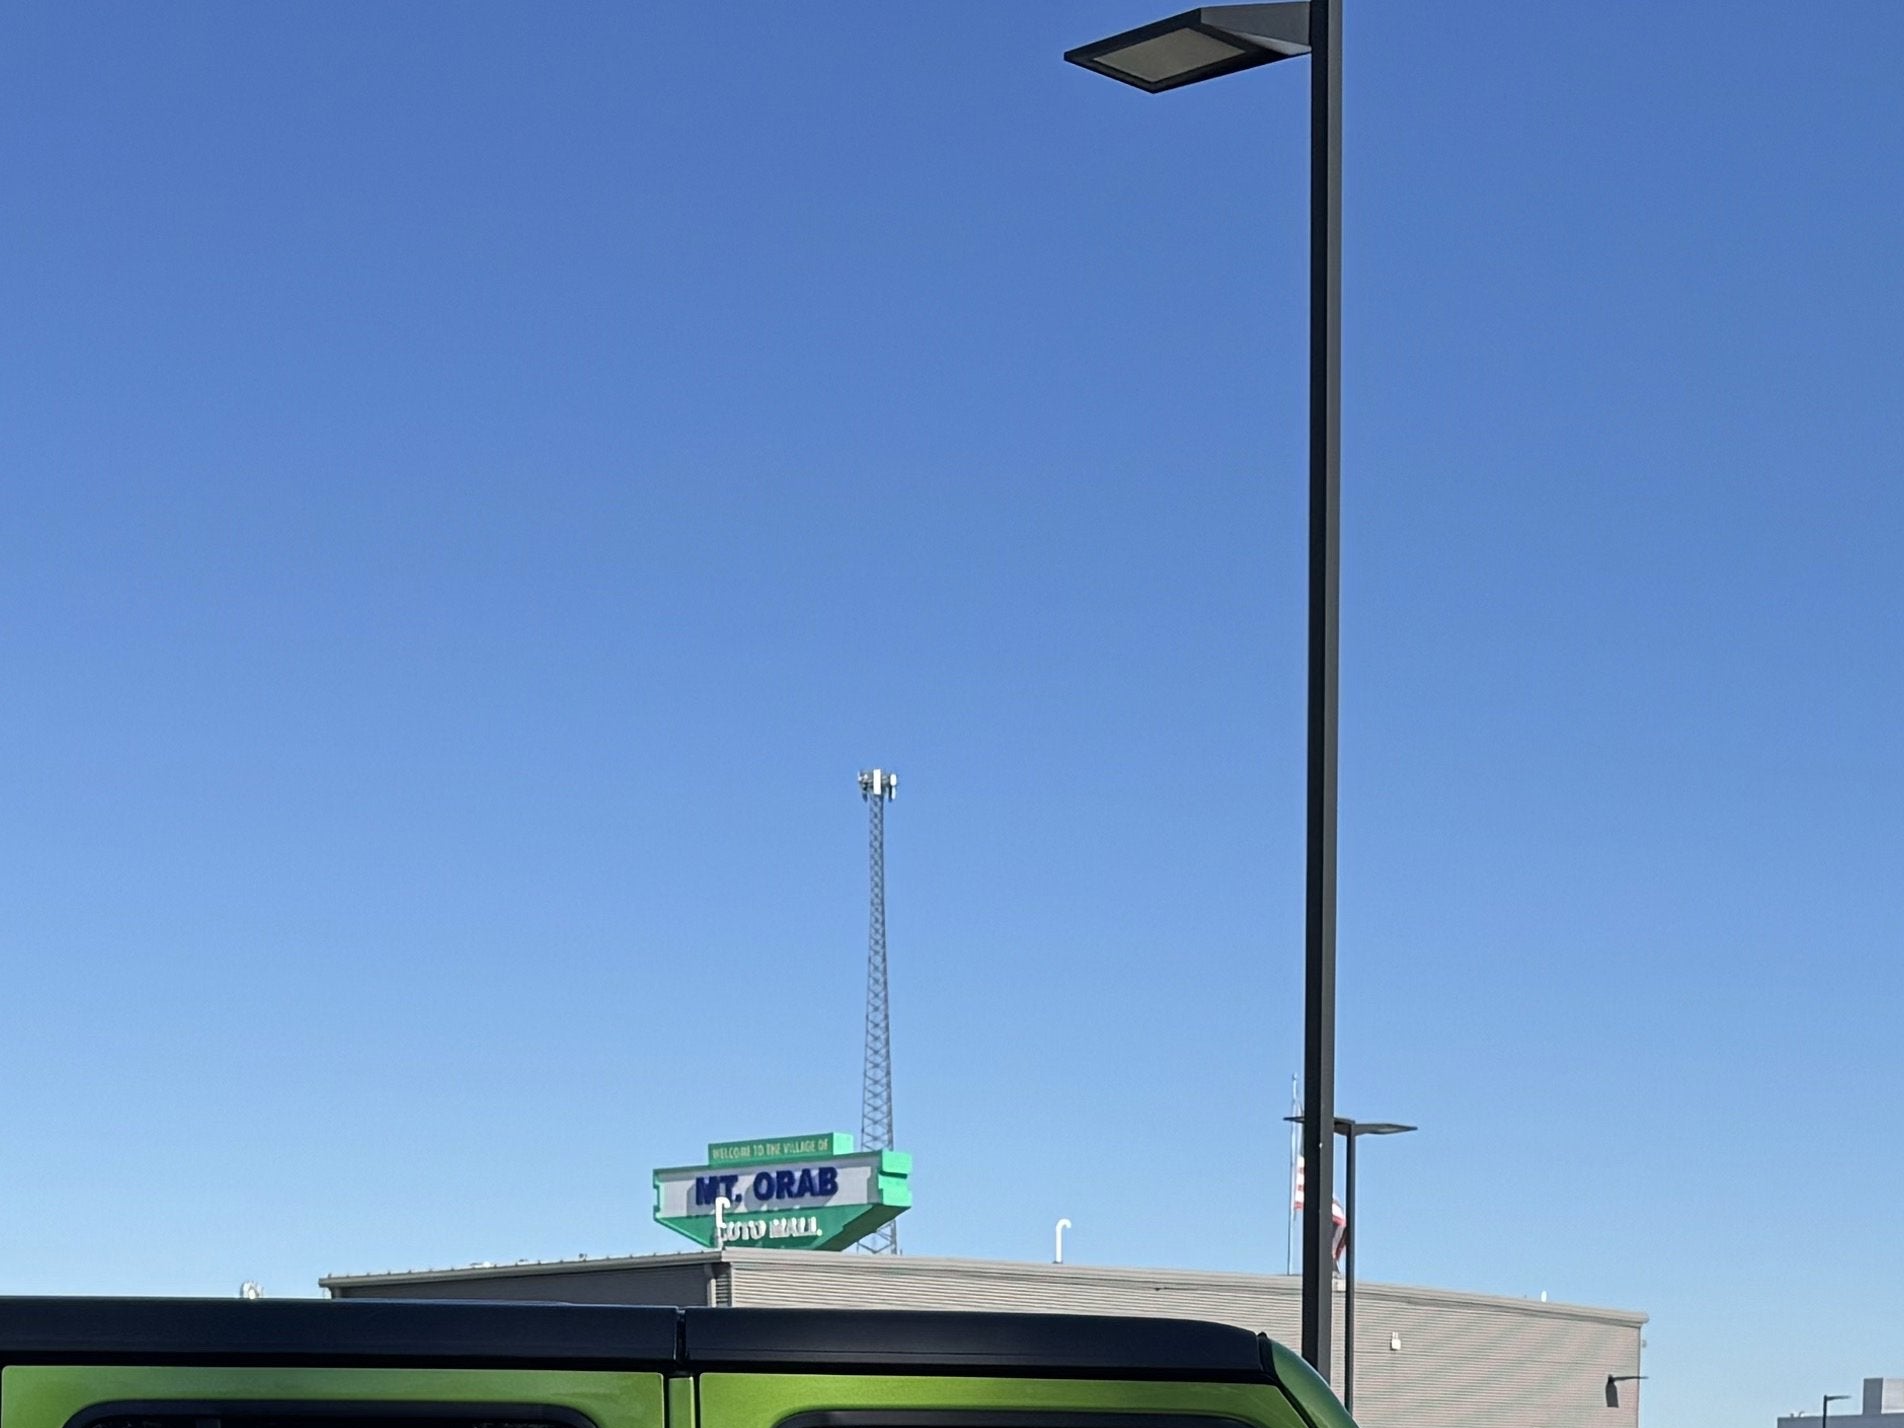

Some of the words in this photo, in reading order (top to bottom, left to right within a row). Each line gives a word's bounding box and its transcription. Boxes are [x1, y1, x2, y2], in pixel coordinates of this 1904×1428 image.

[712, 1145, 751, 1159] WELCOME
[753, 1144, 765, 1156] TO
[766, 1143, 781, 1155] THE
[783, 1140, 815, 1154] VILLAGE
[818, 1138, 828, 1151] OF
[696, 1174, 742, 1206] MT.
[753, 1166, 839, 1201] ORAB
